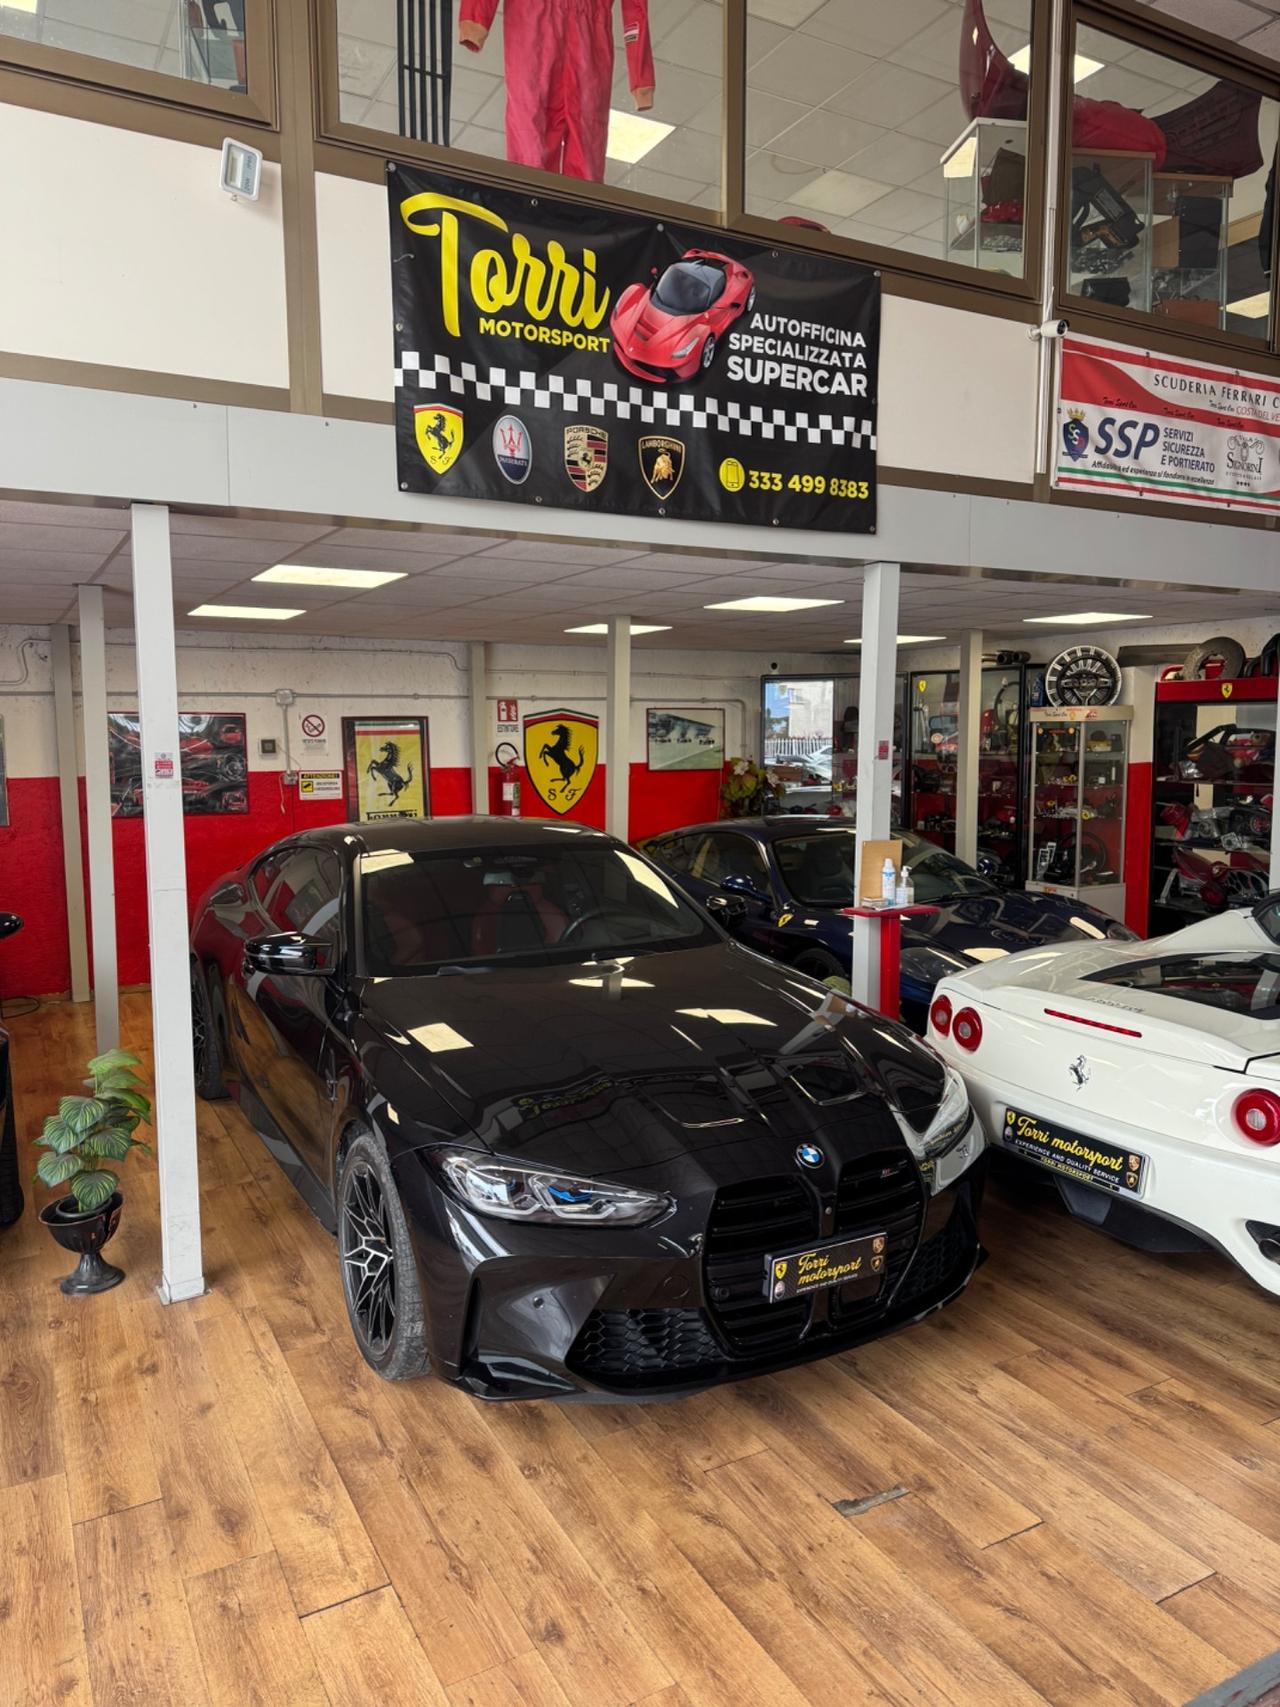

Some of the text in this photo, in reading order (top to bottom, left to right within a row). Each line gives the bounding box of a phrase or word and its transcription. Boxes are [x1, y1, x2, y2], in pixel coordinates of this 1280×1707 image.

[400, 192, 610, 337] Torri
[479, 317, 610, 353] MOTORSPORT
[750, 313, 867, 348] AUTOFFICINA
[728, 332, 867, 369] SPECIALIZZATA
[727, 355, 868, 398] SUPERCAR
[1153, 374, 1217, 396] SCUDERIA
[1221, 386, 1267, 407] FERRARI
[566, 426, 607, 440] PORSCHE
[641, 439, 682, 453] LAMBORGHINI
[1094, 416, 1160, 460] SSP
[1162, 441, 1206, 458] SICUREZZA
[1163, 427, 1194, 442] SERVIZI
[1160, 454, 1215, 473] E PORTIERATO
[749, 470, 869, 499] 333 499 8383
[1017, 1116, 1123, 1171] Torri motorsport
[1014, 1138, 1120, 1184] EXPERIENCE AND QUALITY SERVICE
[797, 1256, 862, 1286] motorsport
[798, 1252, 829, 1274] Torri
